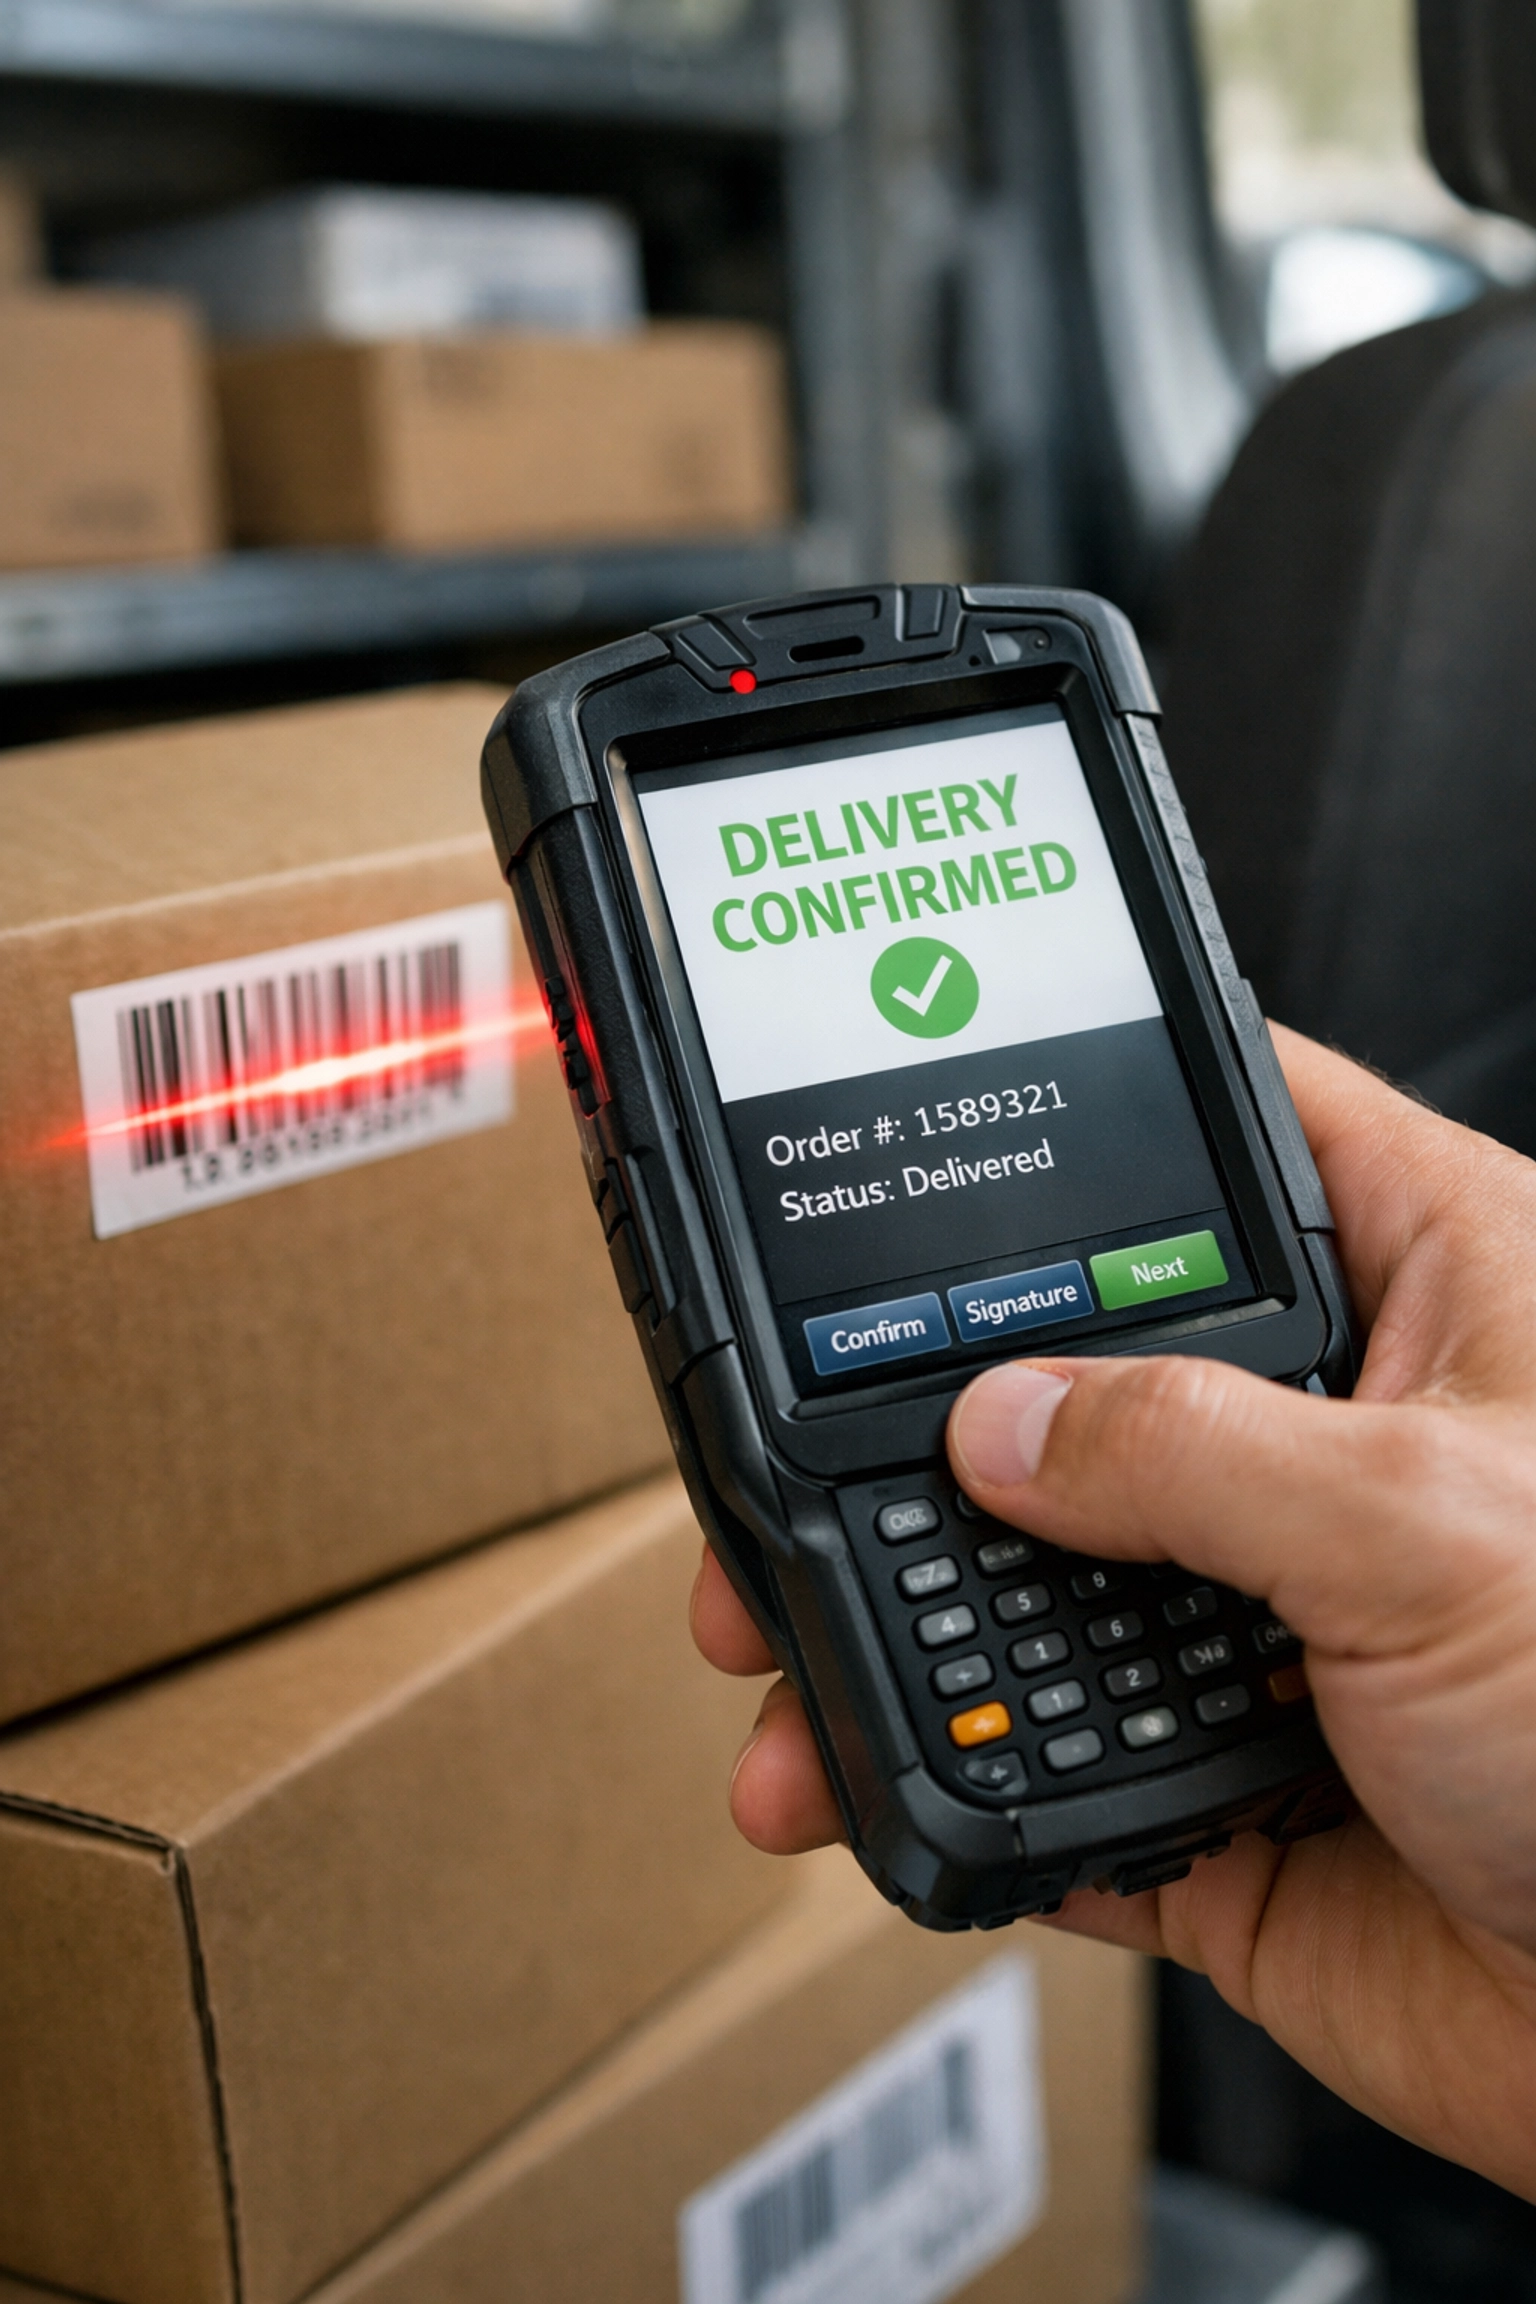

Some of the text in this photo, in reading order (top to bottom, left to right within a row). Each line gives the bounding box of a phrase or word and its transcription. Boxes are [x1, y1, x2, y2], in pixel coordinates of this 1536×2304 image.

[718, 774, 1018, 877] DELIVERY
[711, 841, 1077, 952] CONFIRMED
[766, 1081, 1068, 1167] Order #: 1589321
[780, 1138, 1055, 1222] Status: Delivered
[1130, 1256, 1189, 1286] Next
[965, 1285, 1078, 1325] Signature
[831, 1319, 927, 1353] Confirm
[1016, 1592, 1032, 1612] 5
[940, 1615, 957, 1634] 4
[1109, 1619, 1124, 1638] 6
[1034, 1640, 1049, 1660] 1
[1125, 1667, 1142, 1688] 2
